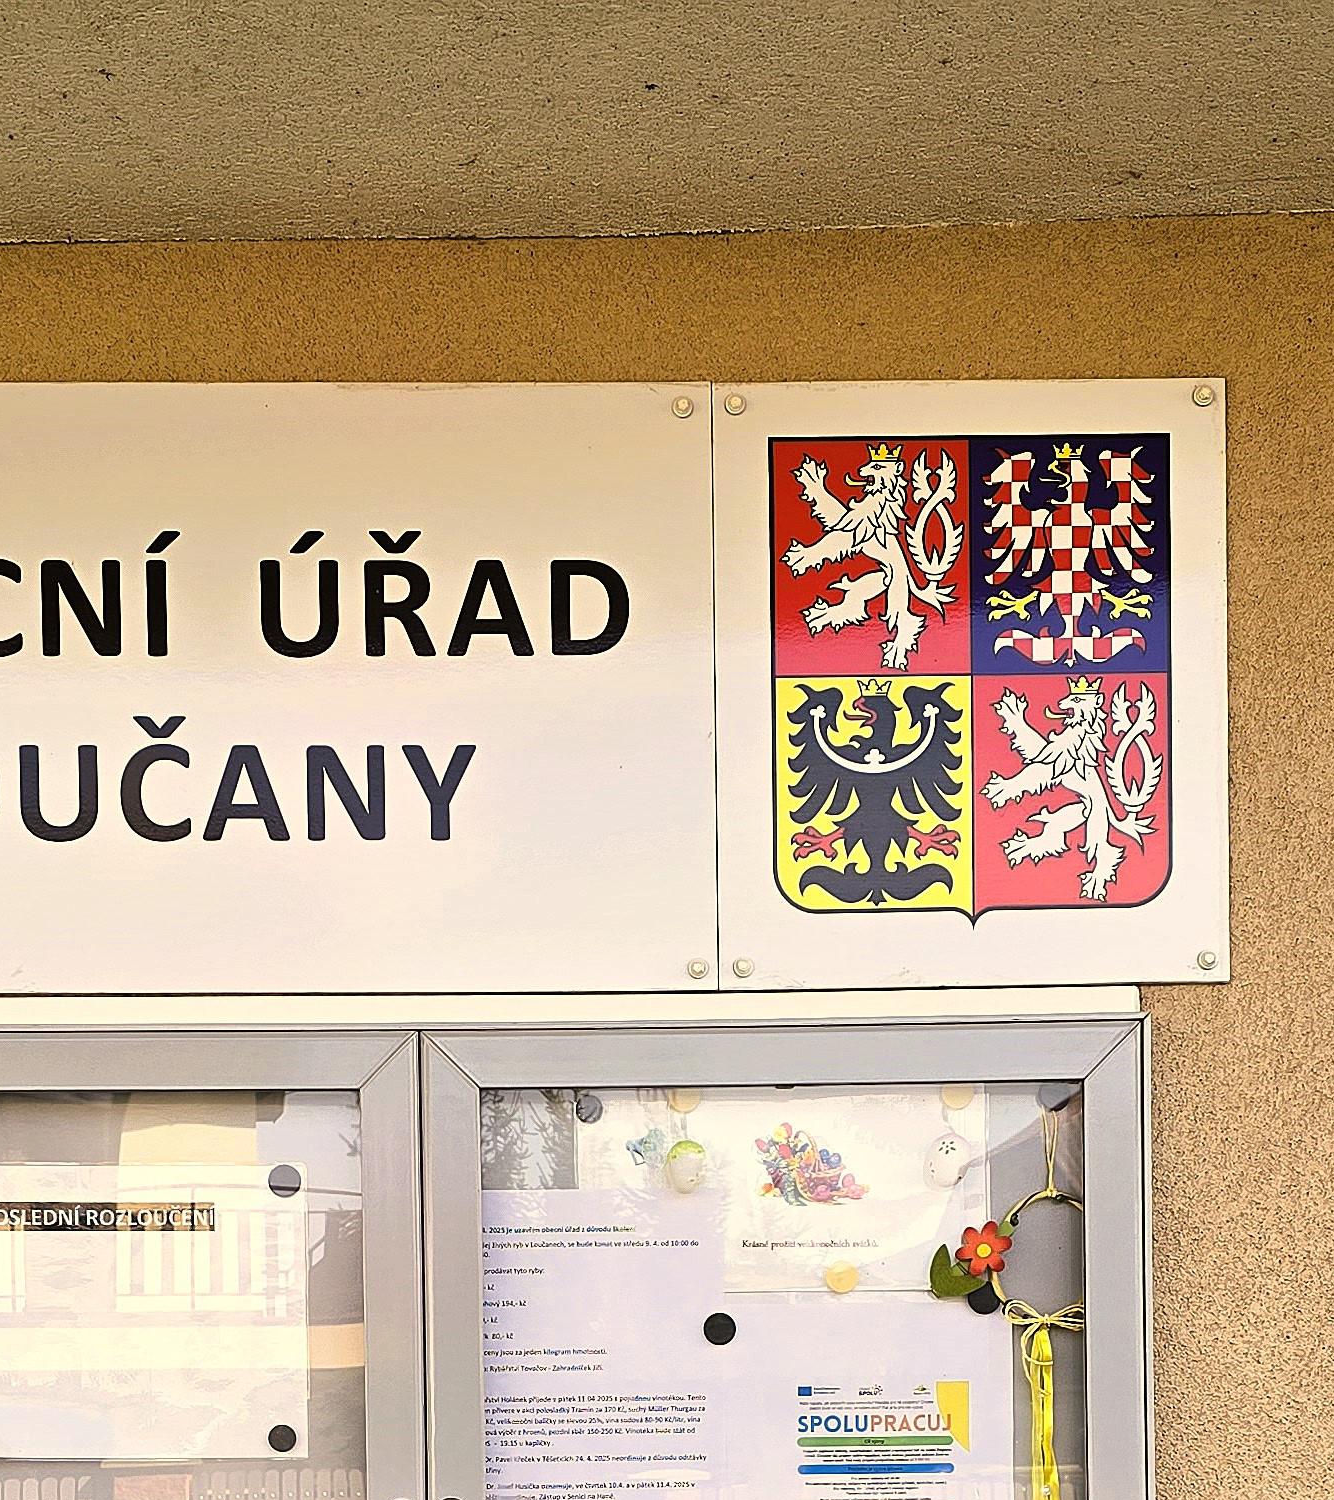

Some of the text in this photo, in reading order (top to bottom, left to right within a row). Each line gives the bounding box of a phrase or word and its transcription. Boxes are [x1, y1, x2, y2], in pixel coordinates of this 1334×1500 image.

[259, 530, 631, 658] ÚŘAD
[86, 1205, 214, 1226] ROZLOUČENÍ
[798, 1414, 952, 1432] SPOLUPRACUJ
